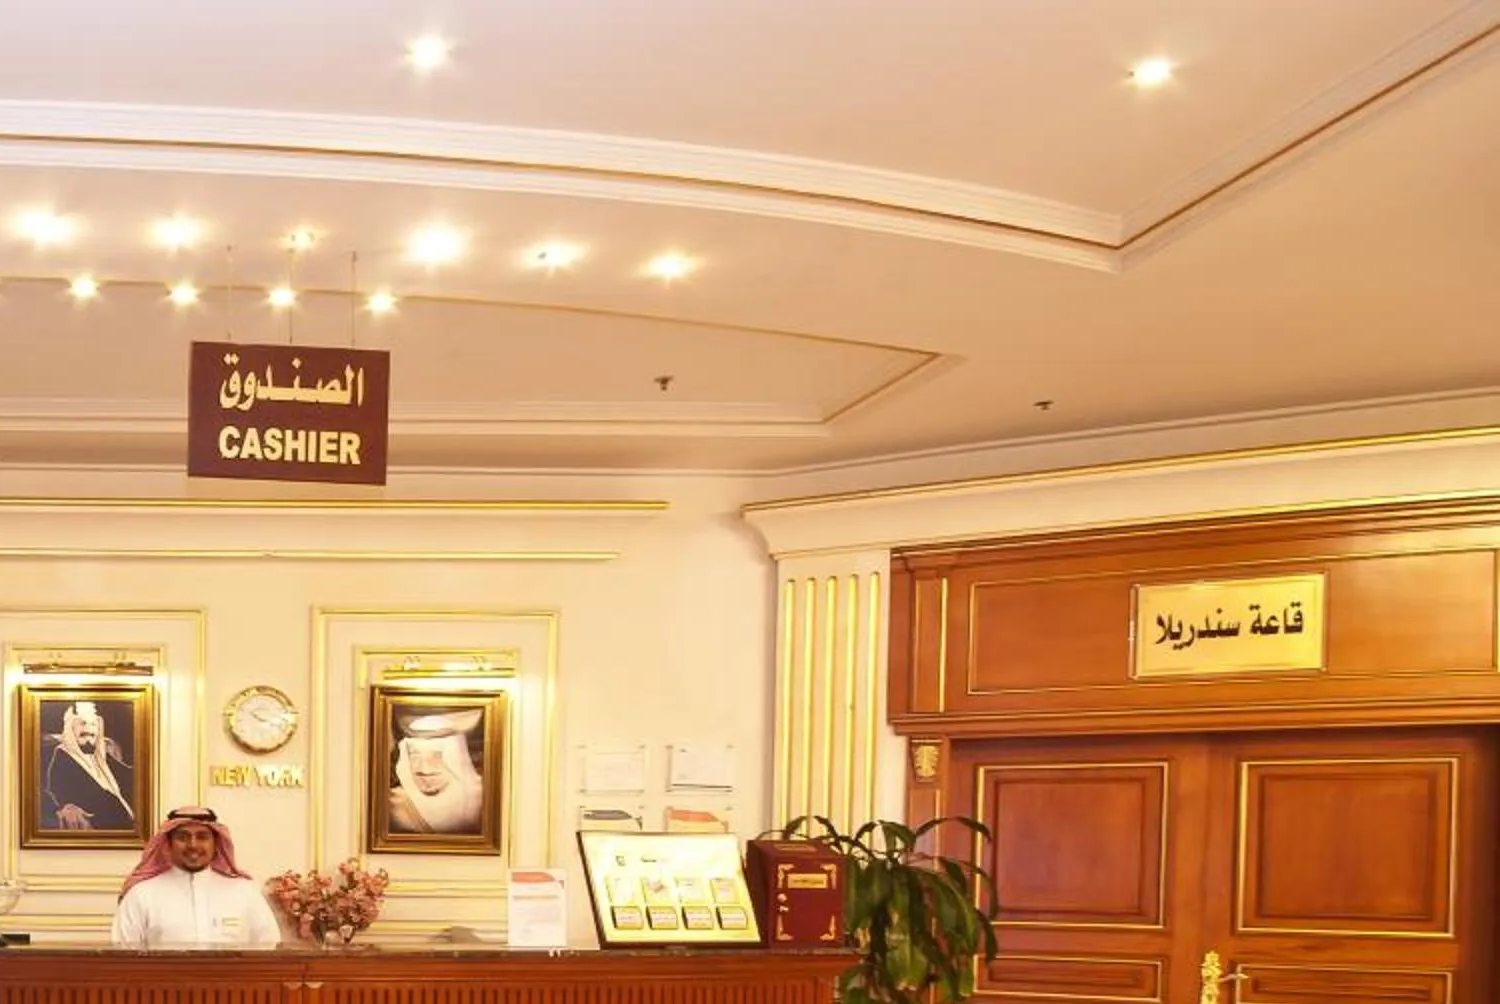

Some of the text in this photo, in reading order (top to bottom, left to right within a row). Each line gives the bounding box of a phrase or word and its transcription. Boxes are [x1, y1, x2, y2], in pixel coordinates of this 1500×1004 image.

[219, 352, 365, 410] الصندوق
[219, 426, 361, 464] CASHIER
[1155, 601, 1304, 650] قاعة سندريلا
[209, 764, 304, 789] NEW YORK
